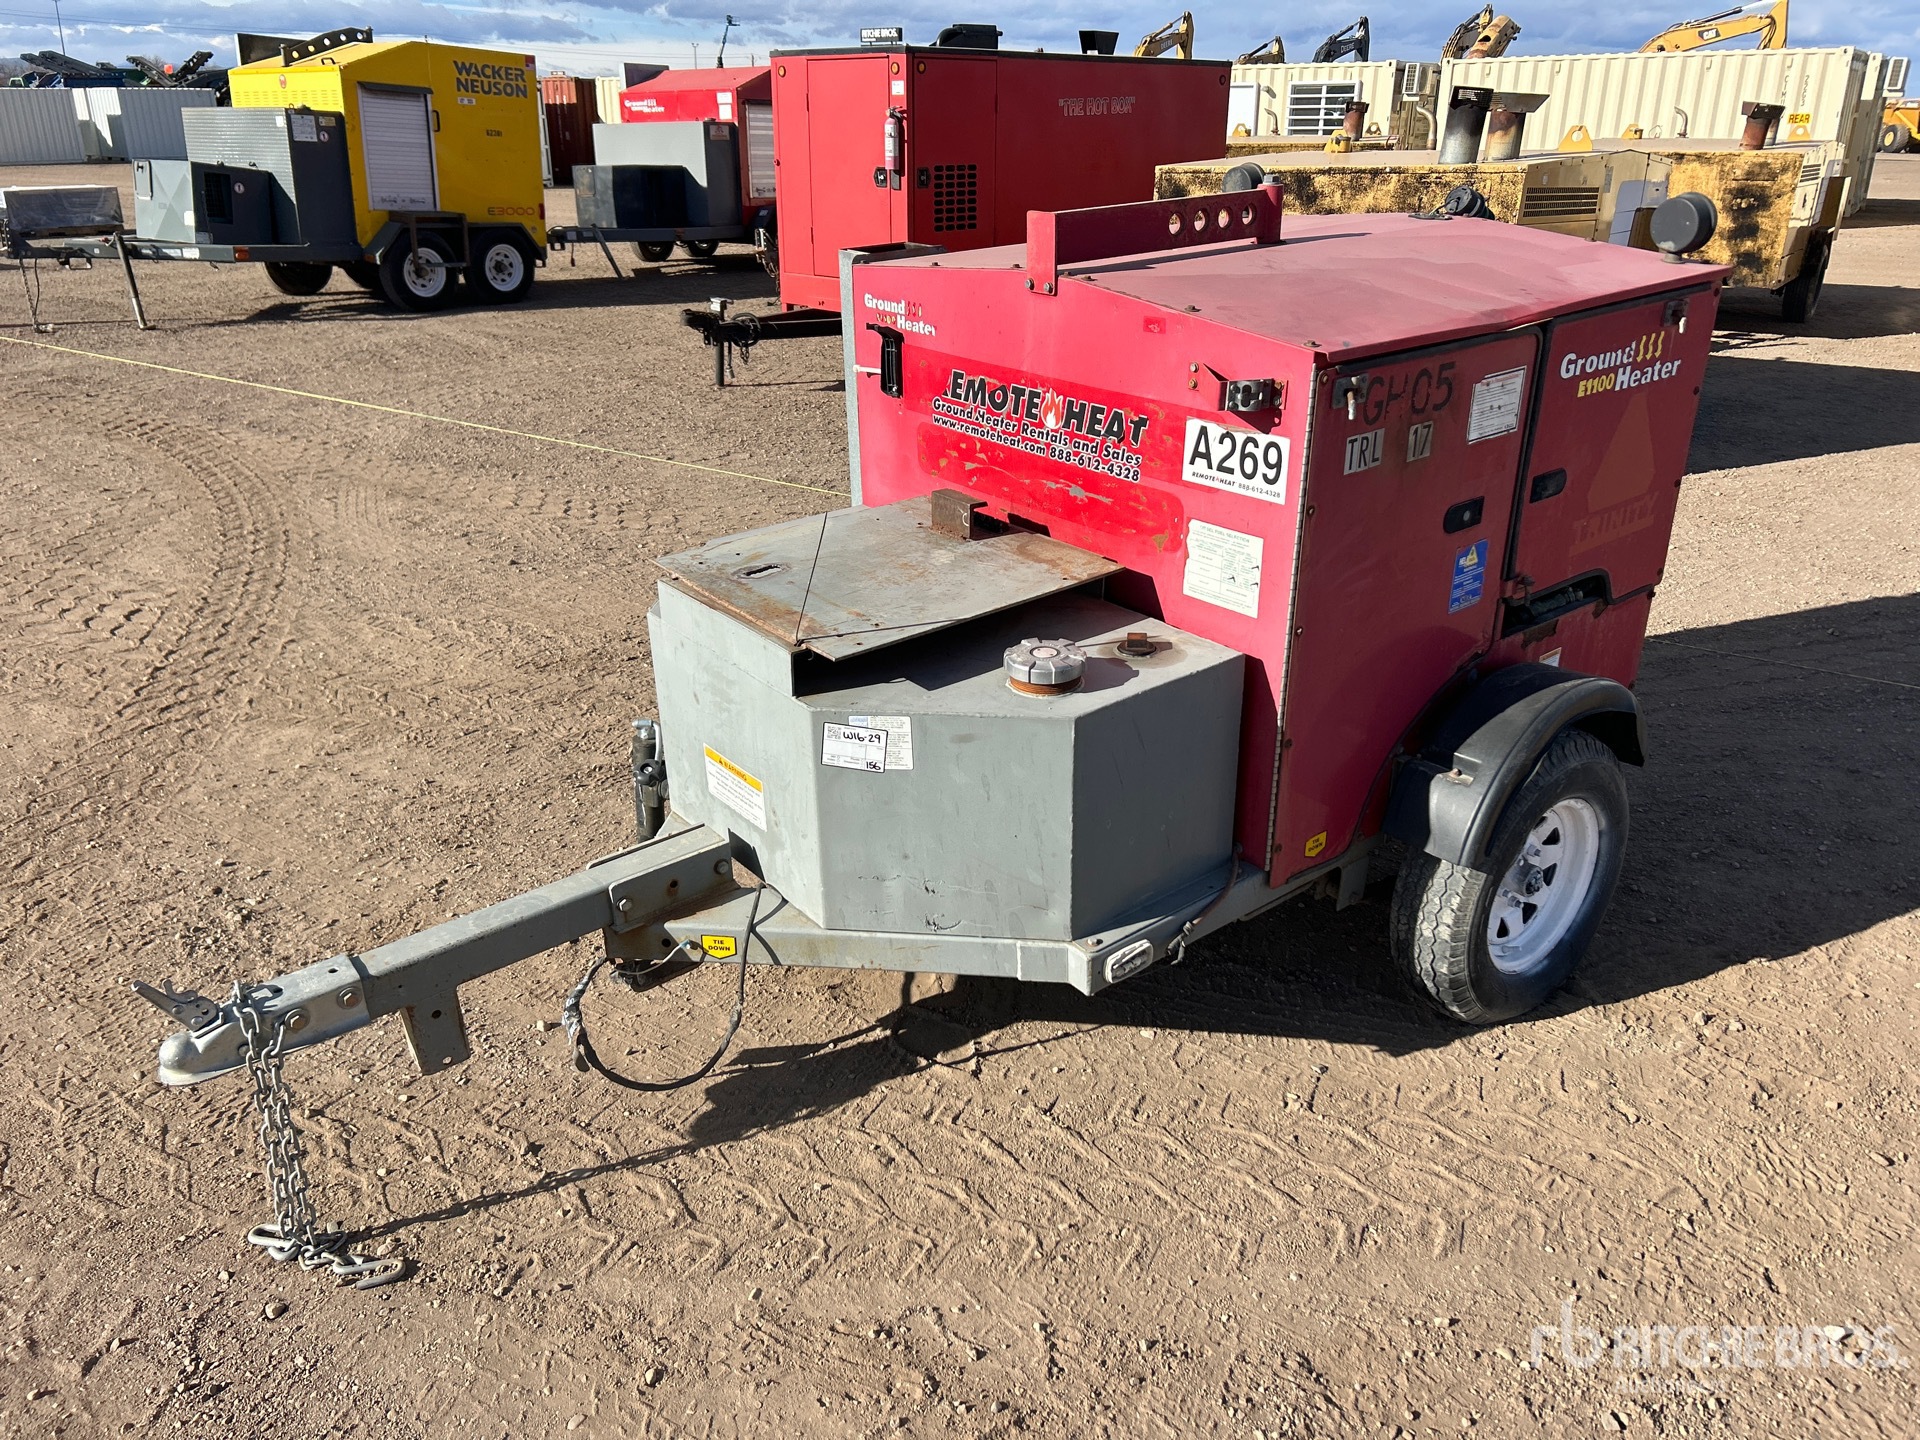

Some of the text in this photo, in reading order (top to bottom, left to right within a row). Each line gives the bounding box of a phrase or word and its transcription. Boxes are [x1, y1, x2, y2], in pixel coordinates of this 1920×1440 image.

[1340, 42, 1355, 53] DEERE
[453, 60, 527, 83] WACKER
[456, 77, 528, 99] NEUSON
[1059, 96, 1136, 117] "THE HOT BOX"
[1788, 113, 1811, 124] REAR
[487, 206, 536, 216] E3000
[864, 292, 906, 315] Ground
[1560, 340, 1637, 379] Ground
[1577, 359, 1682, 397] E1100 Heater
[932, 396, 974, 421] Ground
[1020, 421, 1071, 447] Rentals
[1071, 438, 1101, 456] and
[1102, 443, 1144, 468] Sales
[1061, 397, 1150, 449] HEAT
[932, 414, 1142, 484] www.remoteheat.com 888-612-4328
[1188, 424, 1284, 487] A269
[1347, 422, 1433, 471] TRL 17
[1191, 471, 1282, 499] REMOTE HEAT 888-612-4328
[843, 731, 881, 744] W16-29
[866, 760, 881, 771] 156
